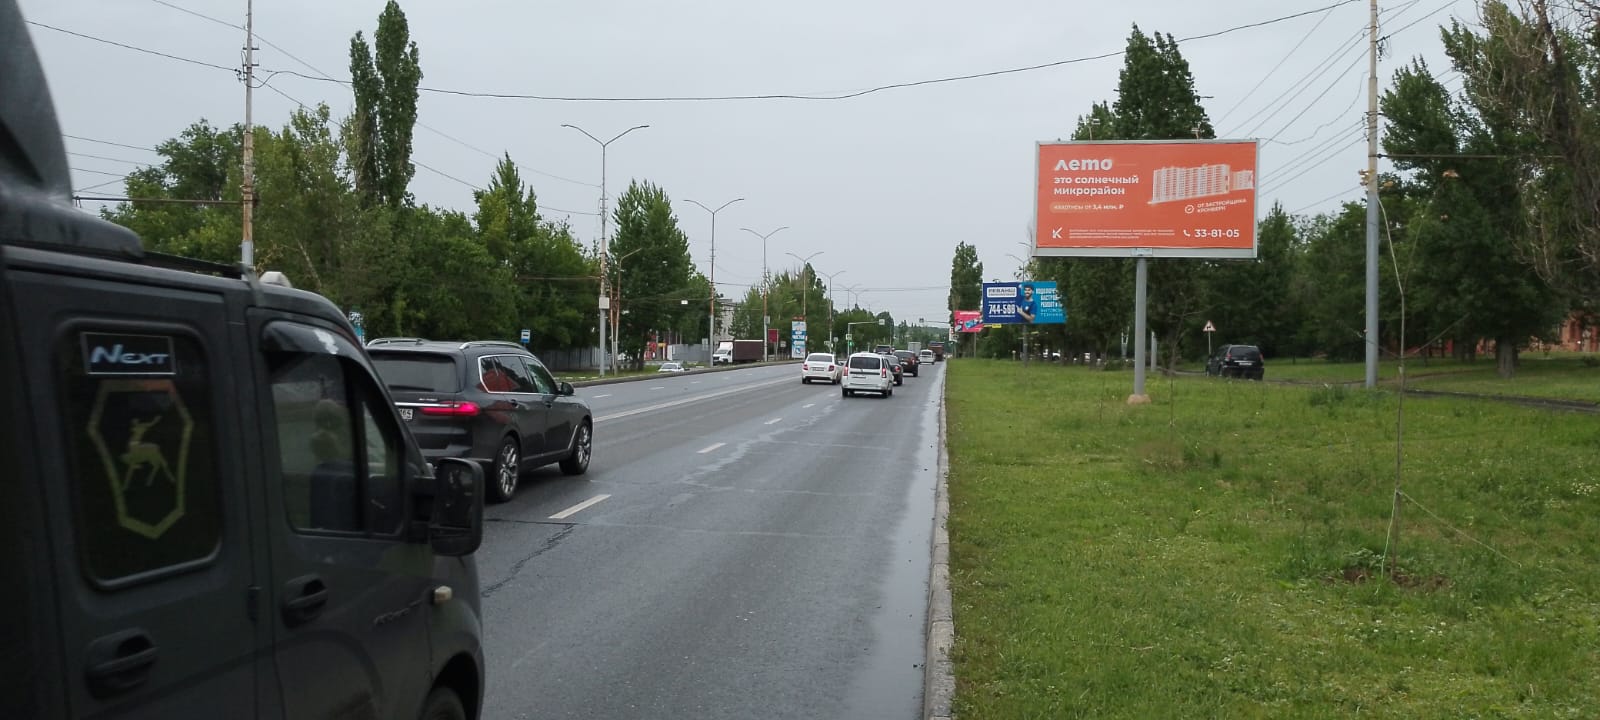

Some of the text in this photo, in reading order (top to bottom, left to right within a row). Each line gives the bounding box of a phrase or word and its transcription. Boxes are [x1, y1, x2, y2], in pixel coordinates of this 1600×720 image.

[1075, 175, 1139, 184] солнечный
[1054, 186, 1125, 197] микрорайон
[1194, 229, 1240, 238] 33-81-05
